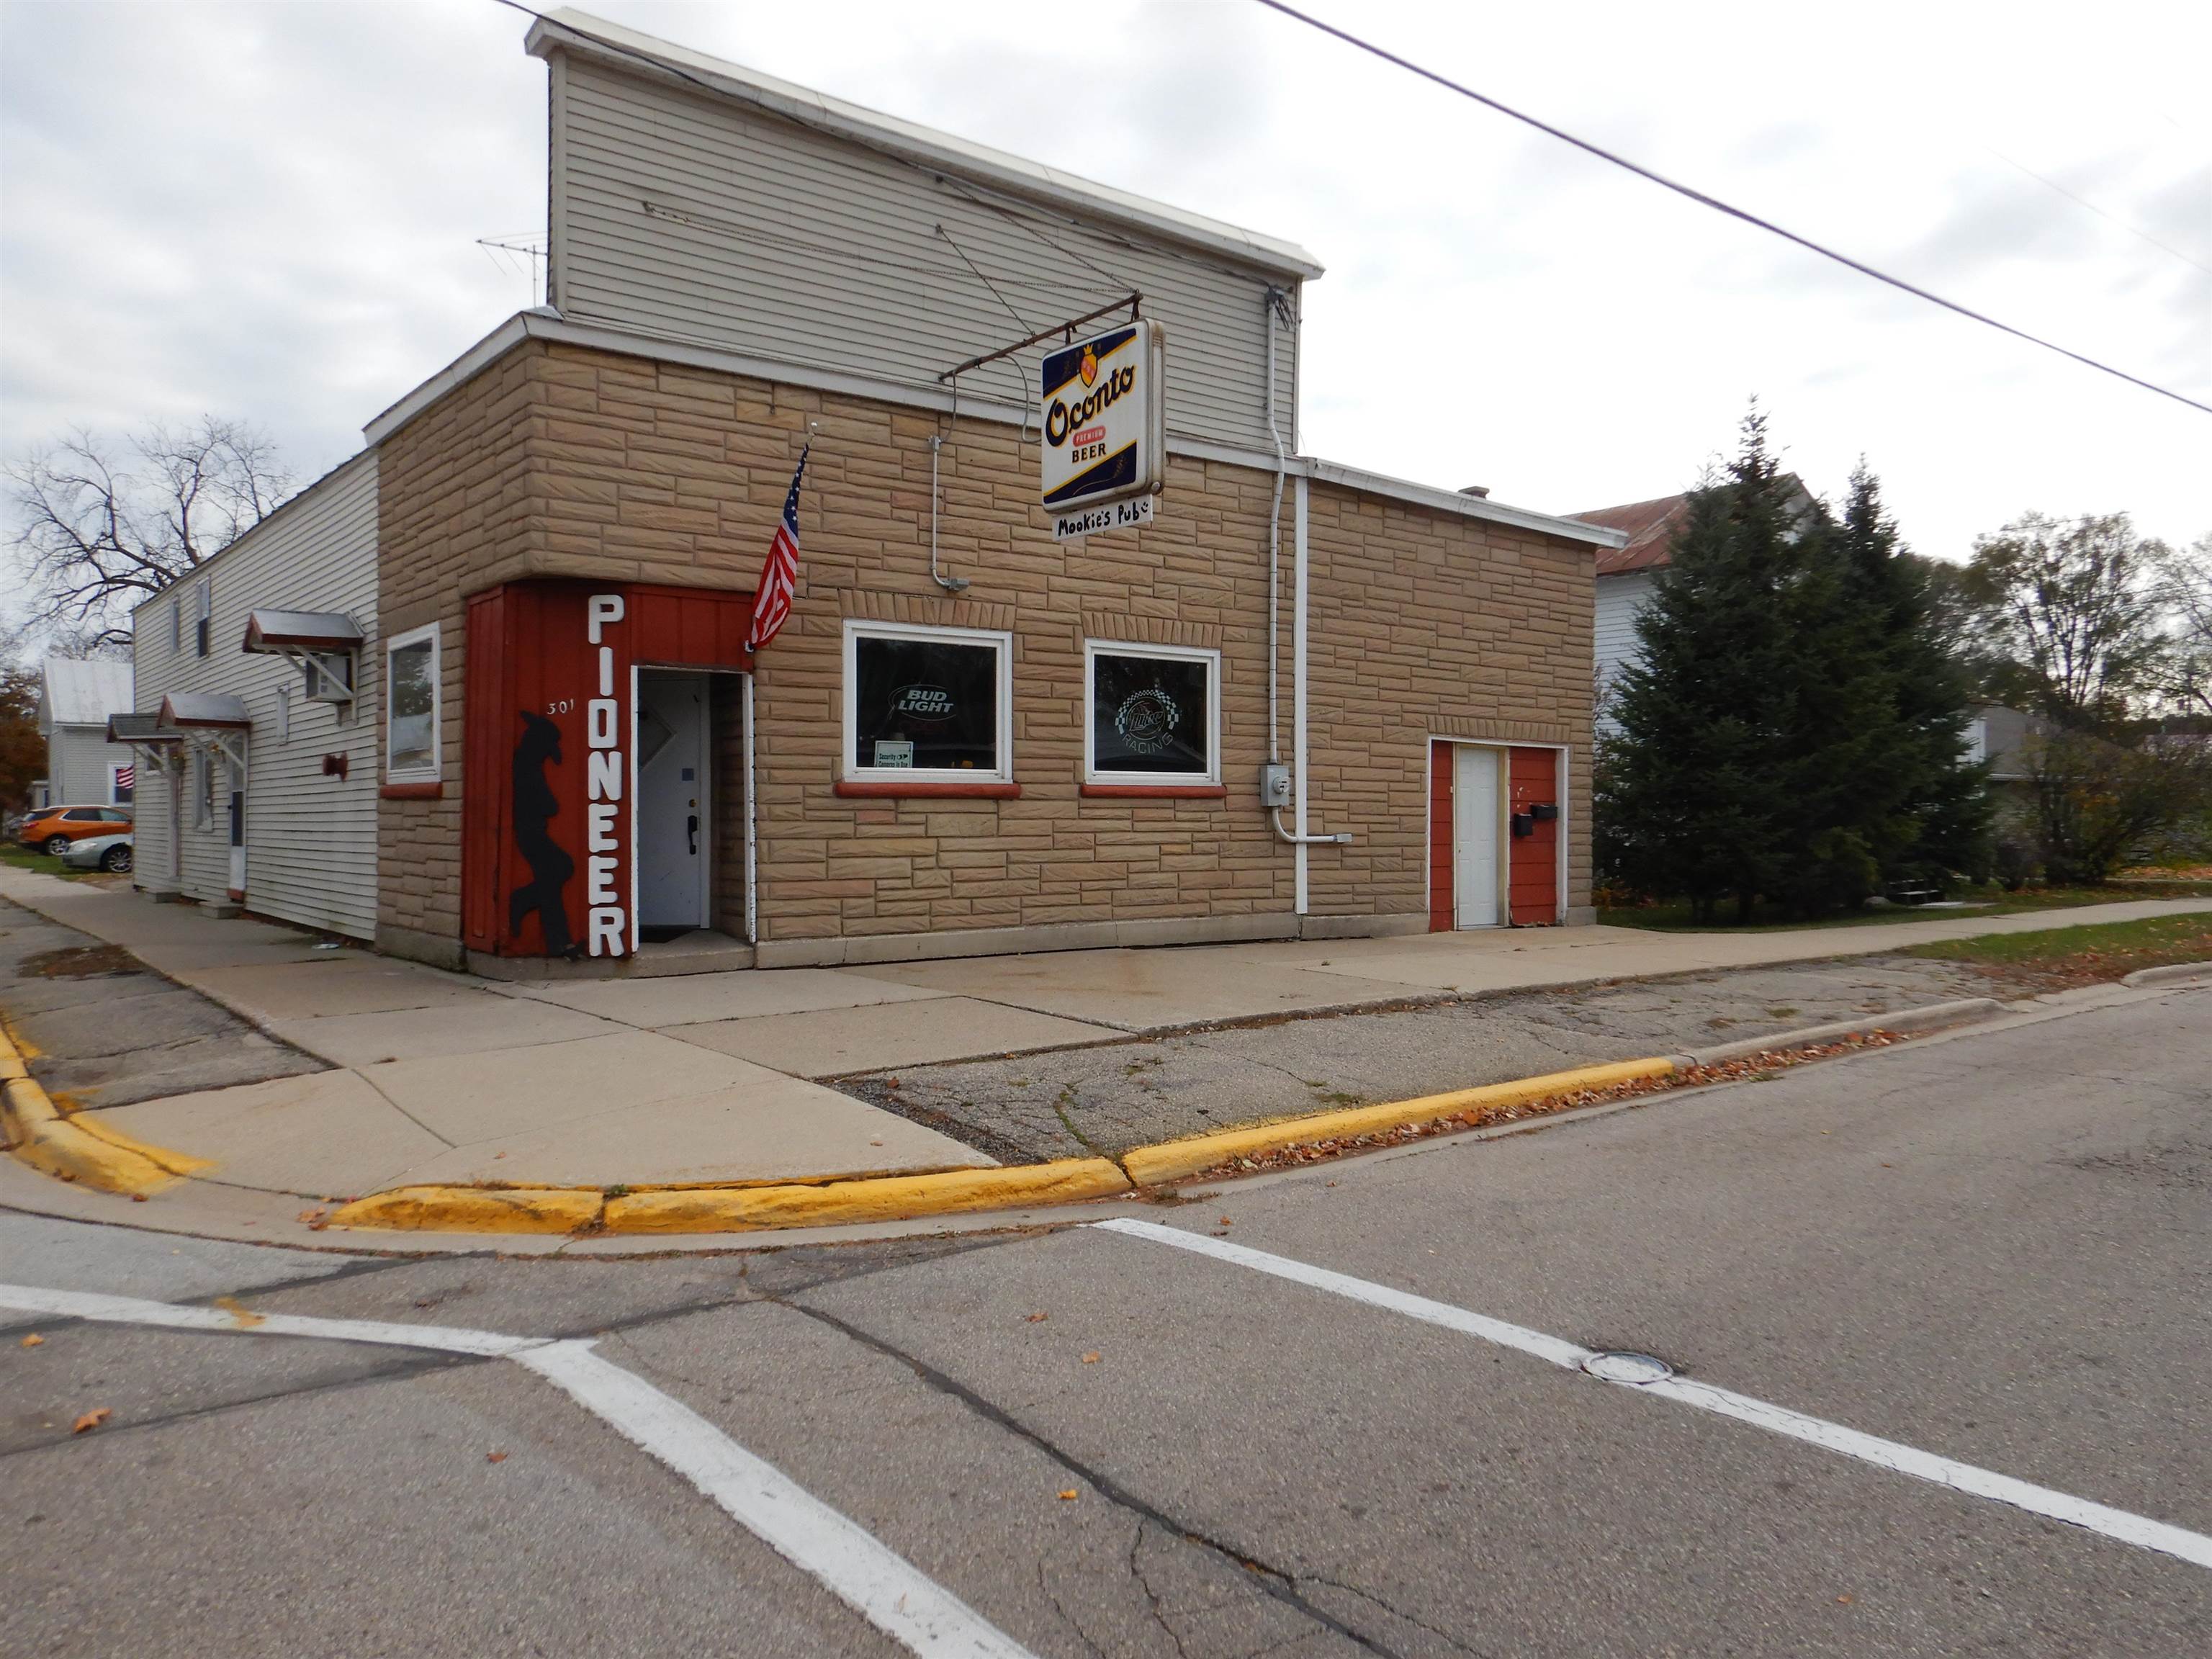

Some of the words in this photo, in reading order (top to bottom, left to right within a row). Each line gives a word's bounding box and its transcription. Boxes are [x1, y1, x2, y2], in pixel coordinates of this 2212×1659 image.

[1046, 365, 1135, 447] Oconto
[1075, 429, 1105, 444] PREMIUM
[1071, 444, 1107, 463] BEER
[1058, 511, 1110, 536] Mookie's
[1118, 503, 1140, 524] Pub
[907, 690, 947, 701] BUD
[547, 698, 574, 714] 501
[899, 700, 953, 713] LIGHT
[1122, 732, 1174, 754] RACING
[588, 594, 625, 957] PIONEER
